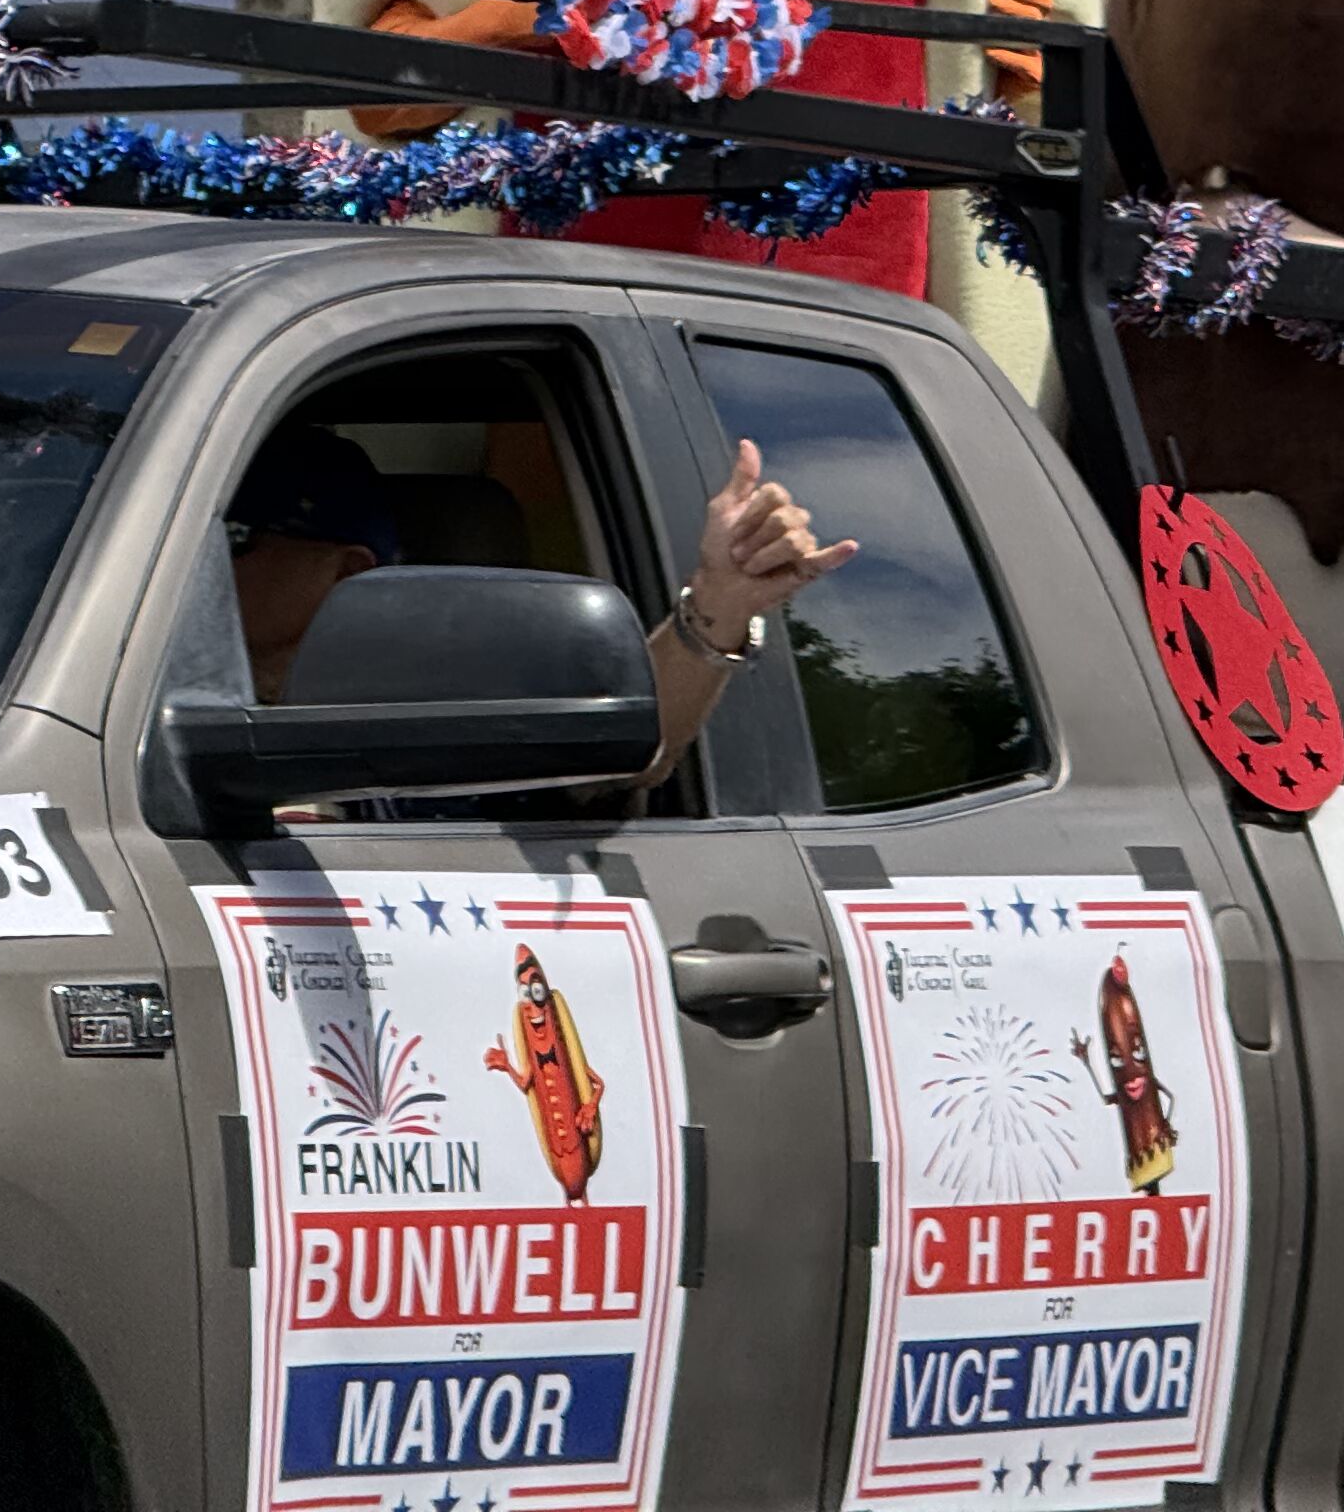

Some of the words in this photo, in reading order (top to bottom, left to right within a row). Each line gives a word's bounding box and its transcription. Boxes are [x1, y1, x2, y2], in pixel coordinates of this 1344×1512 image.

[297, 1140, 482, 1196] FRANKLIN
[295, 1221, 637, 1321] BUNWELL
[910, 1203, 1211, 1288] CHERRY
[451, 1331, 484, 1353] FOR
[1042, 1296, 1075, 1321] FOR
[336, 1372, 571, 1468] MAYOR
[901, 1347, 1018, 1429] VICE
[1026, 1335, 1192, 1420] MAYOR
